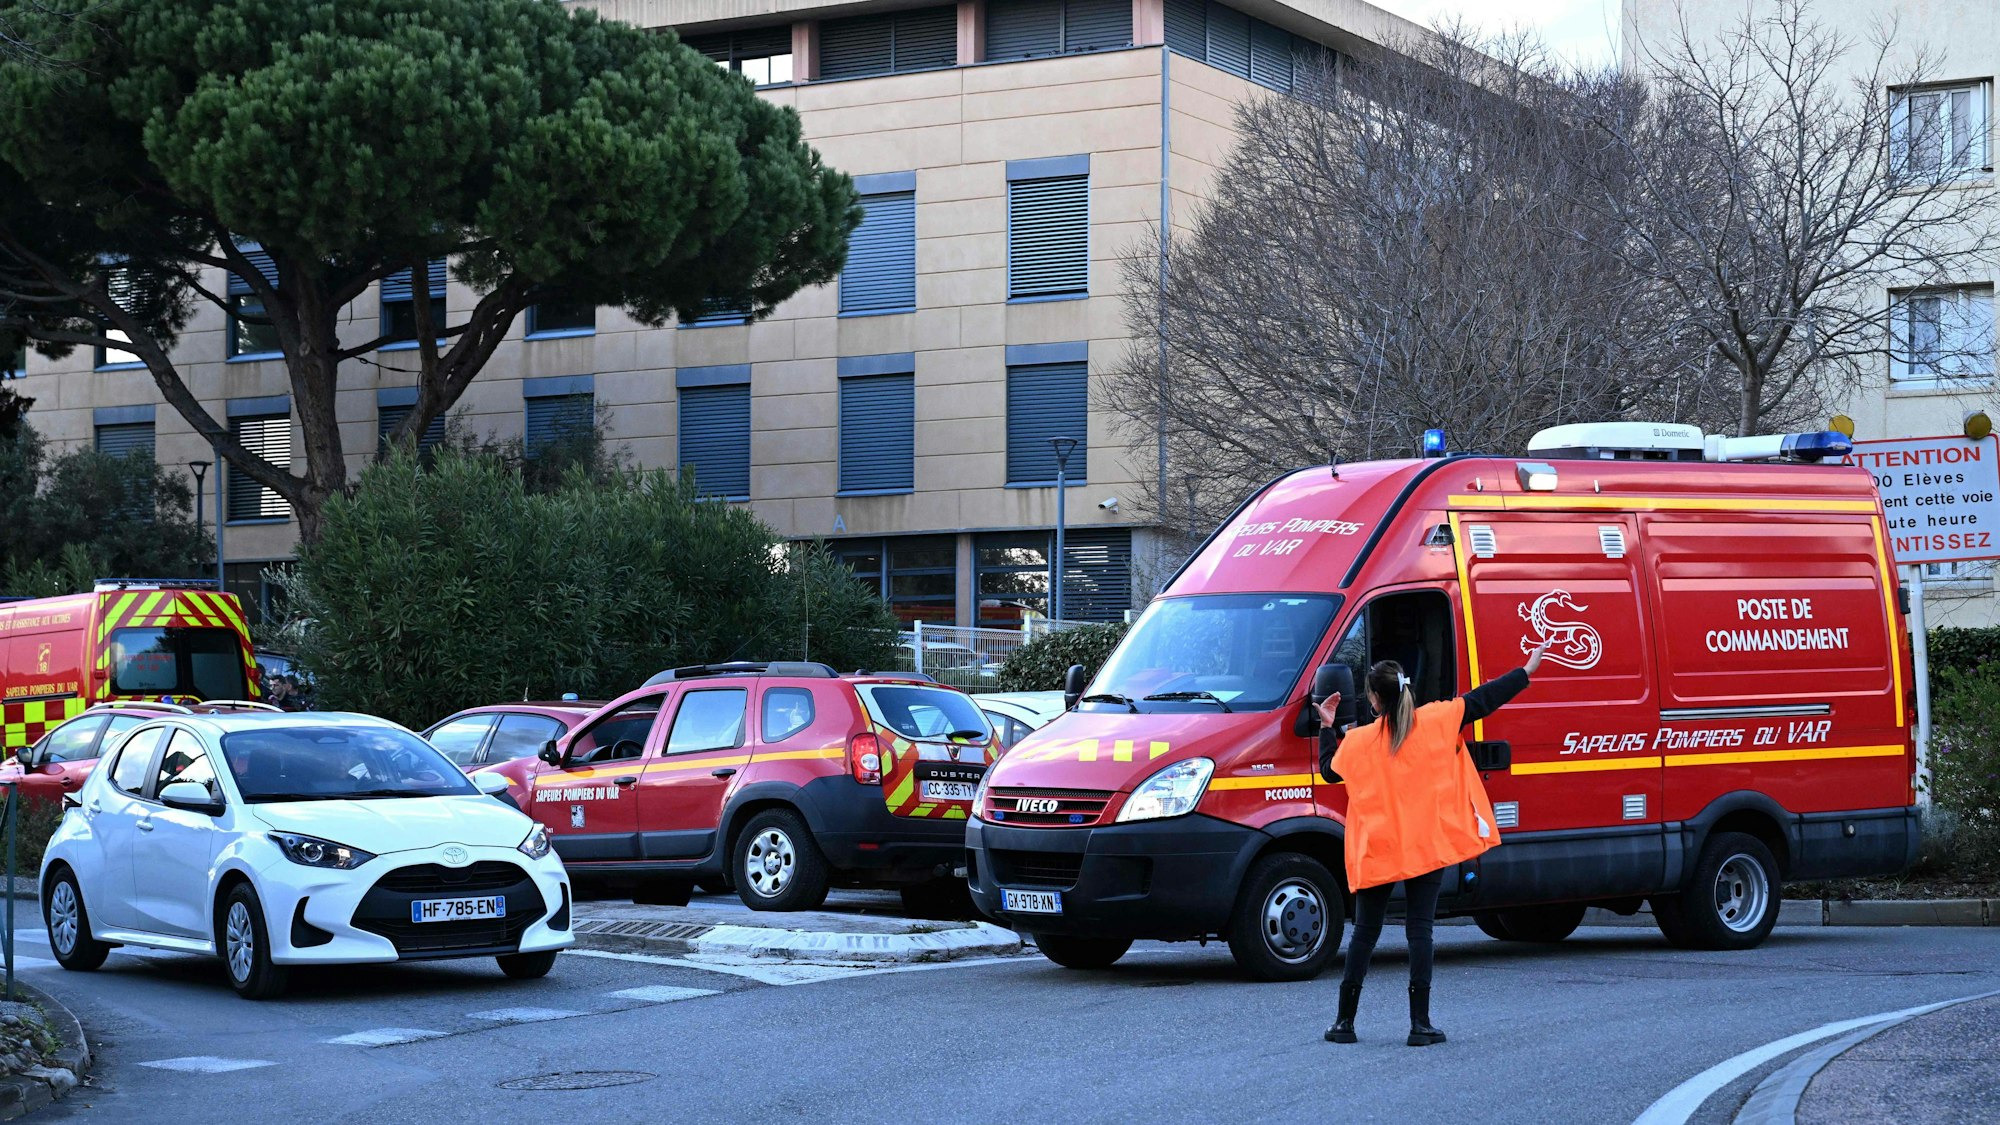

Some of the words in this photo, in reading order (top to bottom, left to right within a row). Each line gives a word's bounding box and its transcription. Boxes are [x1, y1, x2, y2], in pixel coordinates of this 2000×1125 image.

[1661, 428, 1690, 438] Dometic
[1841, 446, 1981, 468] ATTENTION
[1904, 473, 1964, 487] Elèves
[1915, 493, 1955, 506] cette
[1962, 490, 1993, 503] voie
[832, 514, 847, 533] A
[1927, 514, 1978, 527] heure
[1259, 538, 1304, 556] VAR
[1737, 598, 1789, 620] POSTE
[1791, 598, 1813, 619] DE
[1705, 627, 1849, 653] COMMANDEMENT
[5, 686, 28, 697] SAPEURS
[29, 683, 55, 695] POMPIERS
[56, 682, 65, 692] DU
[66, 681, 78, 691] VAR
[1753, 726, 1781, 745] DU
[1787, 720, 1832, 744] VAR
[931, 770, 981, 780] DUSTER
[536, 789, 562, 802] SAPEURS
[563, 787, 594, 801] POMPIERS
[595, 787, 605, 799] DU
[606, 787, 619, 799] VAR
[1265, 787, 1312, 800] PCC00002
[1016, 798, 1059, 813] IVECO
[423, 899, 496, 918] HF-785-EN
[1007, 892, 1054, 910] GX-978-XN
